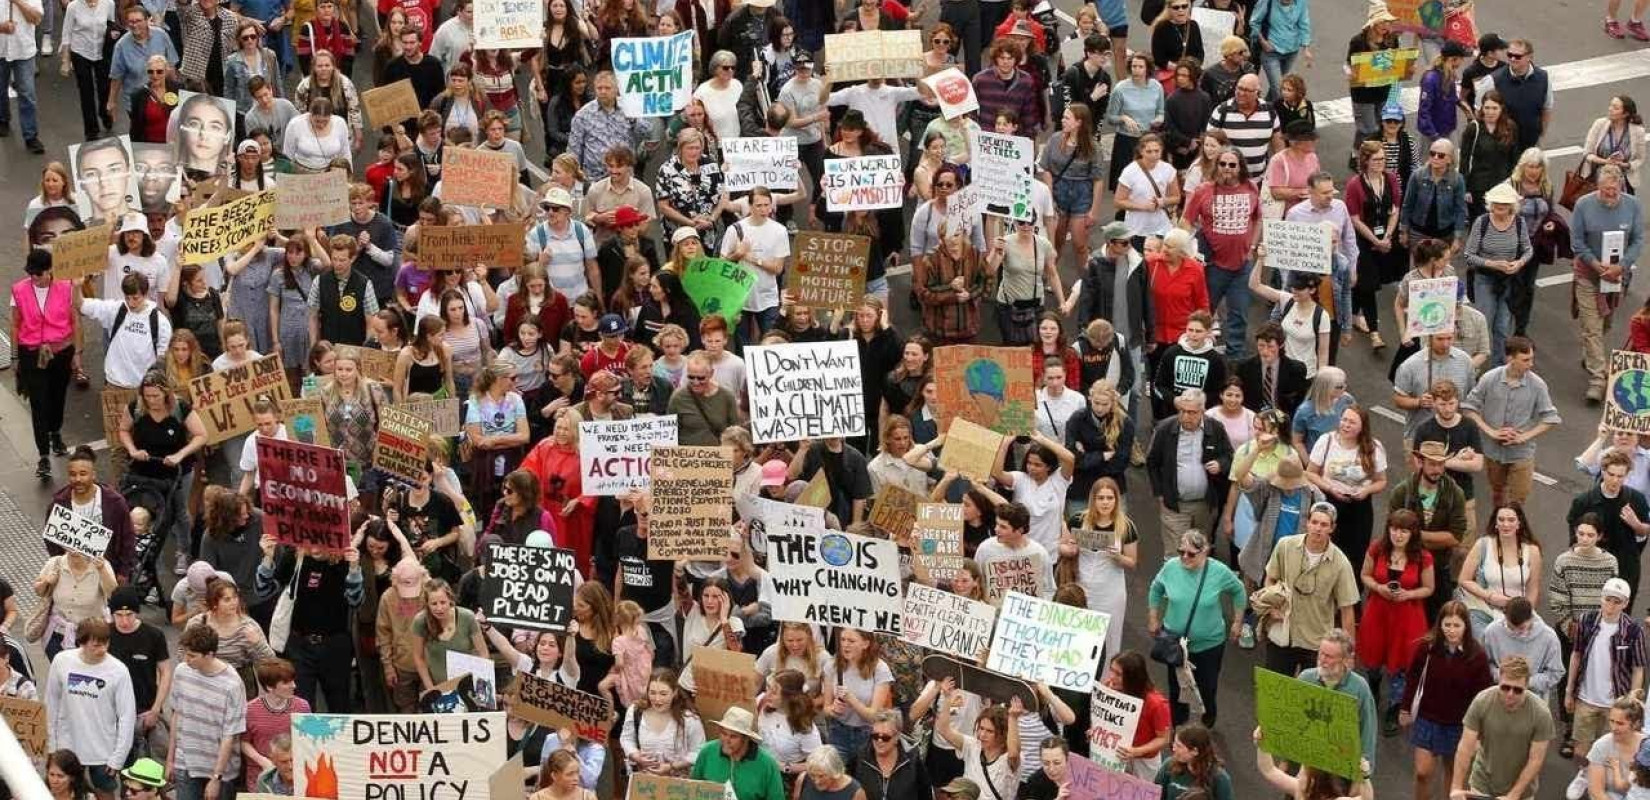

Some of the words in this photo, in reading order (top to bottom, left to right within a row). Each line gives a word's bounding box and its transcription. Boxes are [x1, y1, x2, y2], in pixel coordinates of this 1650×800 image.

[724, 141, 739, 153] WE
[743, 139, 768, 153] ARE
[774, 139, 796, 152] THE
[726, 172, 758, 187] WANT
[761, 171, 778, 184] TO
[828, 174, 846, 188] IS
[850, 172, 877, 187] NOT
[883, 171, 896, 184] A
[190, 213, 219, 228] THE
[222, 197, 251, 222] BEES
[184, 229, 210, 240] ARE
[215, 225, 231, 236] ON
[421, 229, 448, 247] From
[807, 237, 855, 253] STOP
[801, 251, 866, 268] FRACKING
[811, 264, 850, 274] WITH
[801, 275, 853, 289] MOTHER
[800, 287, 856, 305] NATURE
[751, 351, 758, 380] I
[764, 350, 813, 376] DON'T
[811, 348, 857, 370] WANT
[1611, 351, 1648, 375] Earth
[191, 376, 212, 396] IF
[219, 364, 249, 386] YOU
[755, 380, 773, 397] MY
[774, 375, 823, 393] CHILDREN
[821, 372, 861, 391] LIVING
[199, 389, 221, 409] ACT
[753, 399, 769, 419] IN
[774, 397, 786, 417] A
[788, 392, 865, 417] CLIMATE
[208, 402, 238, 433] WE
[381, 407, 430, 432] SYSTEM
[582, 424, 599, 434] WE
[605, 423, 629, 433] NEED
[631, 420, 653, 432] MORE
[657, 419, 679, 430] THAN
[753, 414, 866, 440] WASTELAND
[381, 419, 424, 443] CHANGE
[257, 442, 318, 467] THERE
[325, 455, 343, 472] IS
[604, 444, 619, 453] WE
[653, 449, 671, 458] NO
[671, 449, 697, 459] NEW
[698, 450, 722, 459] COAL
[288, 466, 318, 483] NO
[653, 458, 671, 468] OIL
[679, 459, 700, 468] GAS
[265, 480, 347, 510] ECONOMY
[653, 489, 689, 498] ENERGY
[677, 479, 731, 489] RENEWABLE
[264, 502, 287, 516] ON
[652, 506, 665, 515] BY
[666, 506, 692, 514] 2030
[922, 506, 935, 519] IF
[939, 506, 962, 520] YOU
[46, 523, 73, 545] DEAD
[54, 506, 72, 521] NO
[81, 519, 112, 539] JOBS
[60, 523, 81, 535] ON
[84, 532, 92, 541] A
[650, 519, 674, 529] FUND
[685, 517, 705, 528] JUST
[278, 521, 344, 550] PLANET
[489, 544, 552, 570] THERE'S
[555, 552, 576, 571] NO
[658, 547, 729, 557] COMMUNITIES
[767, 534, 818, 565] THE
[855, 542, 878, 569] IS
[488, 561, 530, 581] JOBS
[534, 567, 557, 583] ON
[560, 571, 573, 587] A
[1008, 557, 1032, 571] OUR
[502, 578, 549, 603] DEAD
[772, 578, 812, 597] WHY
[815, 568, 899, 597] CHANGING
[989, 571, 1035, 588] FUTURE
[910, 585, 946, 604] KEEP
[949, 594, 973, 615] THE
[989, 588, 1002, 598] AT
[493, 597, 565, 622] PLANET
[805, 604, 867, 627] AREN'T
[875, 611, 902, 632] WE
[937, 609, 967, 626] CLEAN
[1007, 595, 1038, 619] THE
[1037, 604, 1109, 637] DINOSAURS
[904, 616, 929, 632] NOT
[929, 623, 991, 657] URANUS
[1002, 618, 1078, 650] THOUGHT
[1000, 636, 1045, 660] THEY
[1051, 647, 1083, 668] HAD
[997, 652, 1048, 682] TIME
[1053, 665, 1091, 688] TOO
[352, 719, 449, 745] DENIAL
[462, 718, 492, 743] IS
[573, 718, 608, 744] WE
[369, 750, 423, 774] NOT
[428, 752, 451, 776] A
[1069, 762, 1097, 793] WE
